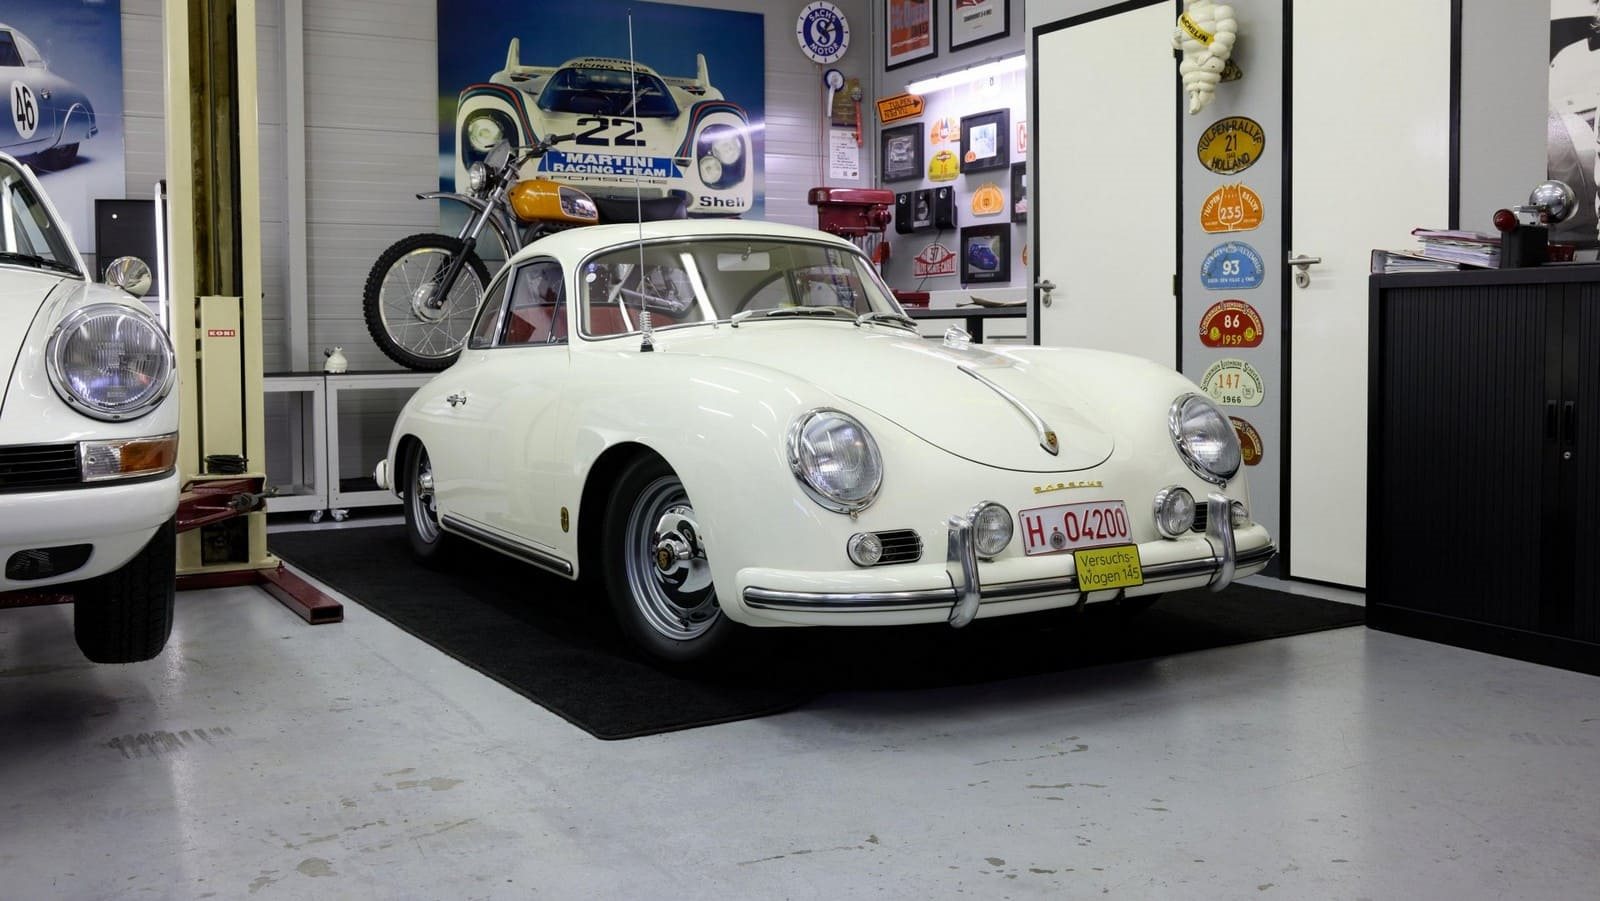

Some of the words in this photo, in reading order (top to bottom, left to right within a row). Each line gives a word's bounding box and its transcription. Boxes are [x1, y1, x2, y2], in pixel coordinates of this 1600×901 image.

[809, 10, 836, 21] SACHS
[1181, 15, 1209, 42] CHELIN
[810, 42, 839, 54] MOTOR
[15, 86, 36, 131] 46
[575, 117, 647, 147] 22
[1225, 134, 1237, 152] 21
[565, 152, 653, 168] MARTINI
[1211, 152, 1250, 170] HOLLAND
[553, 163, 667, 177] RACING-TEAM
[700, 196, 745, 208] Shell
[1203, 194, 1221, 217] TULPEN
[1220, 206, 1241, 220] 235
[1222, 260, 1239, 275] 93
[1224, 314, 1240, 328] 86
[1222, 334, 1242, 345] 1959
[1218, 374, 1240, 389] 147
[1026, 515, 1046, 547] H
[1064, 507, 1127, 543] 04200
[1080, 552, 1134, 567] Versuchs-
[1081, 570, 1121, 586] Wagen
[1122, 566, 1140, 580] 145
